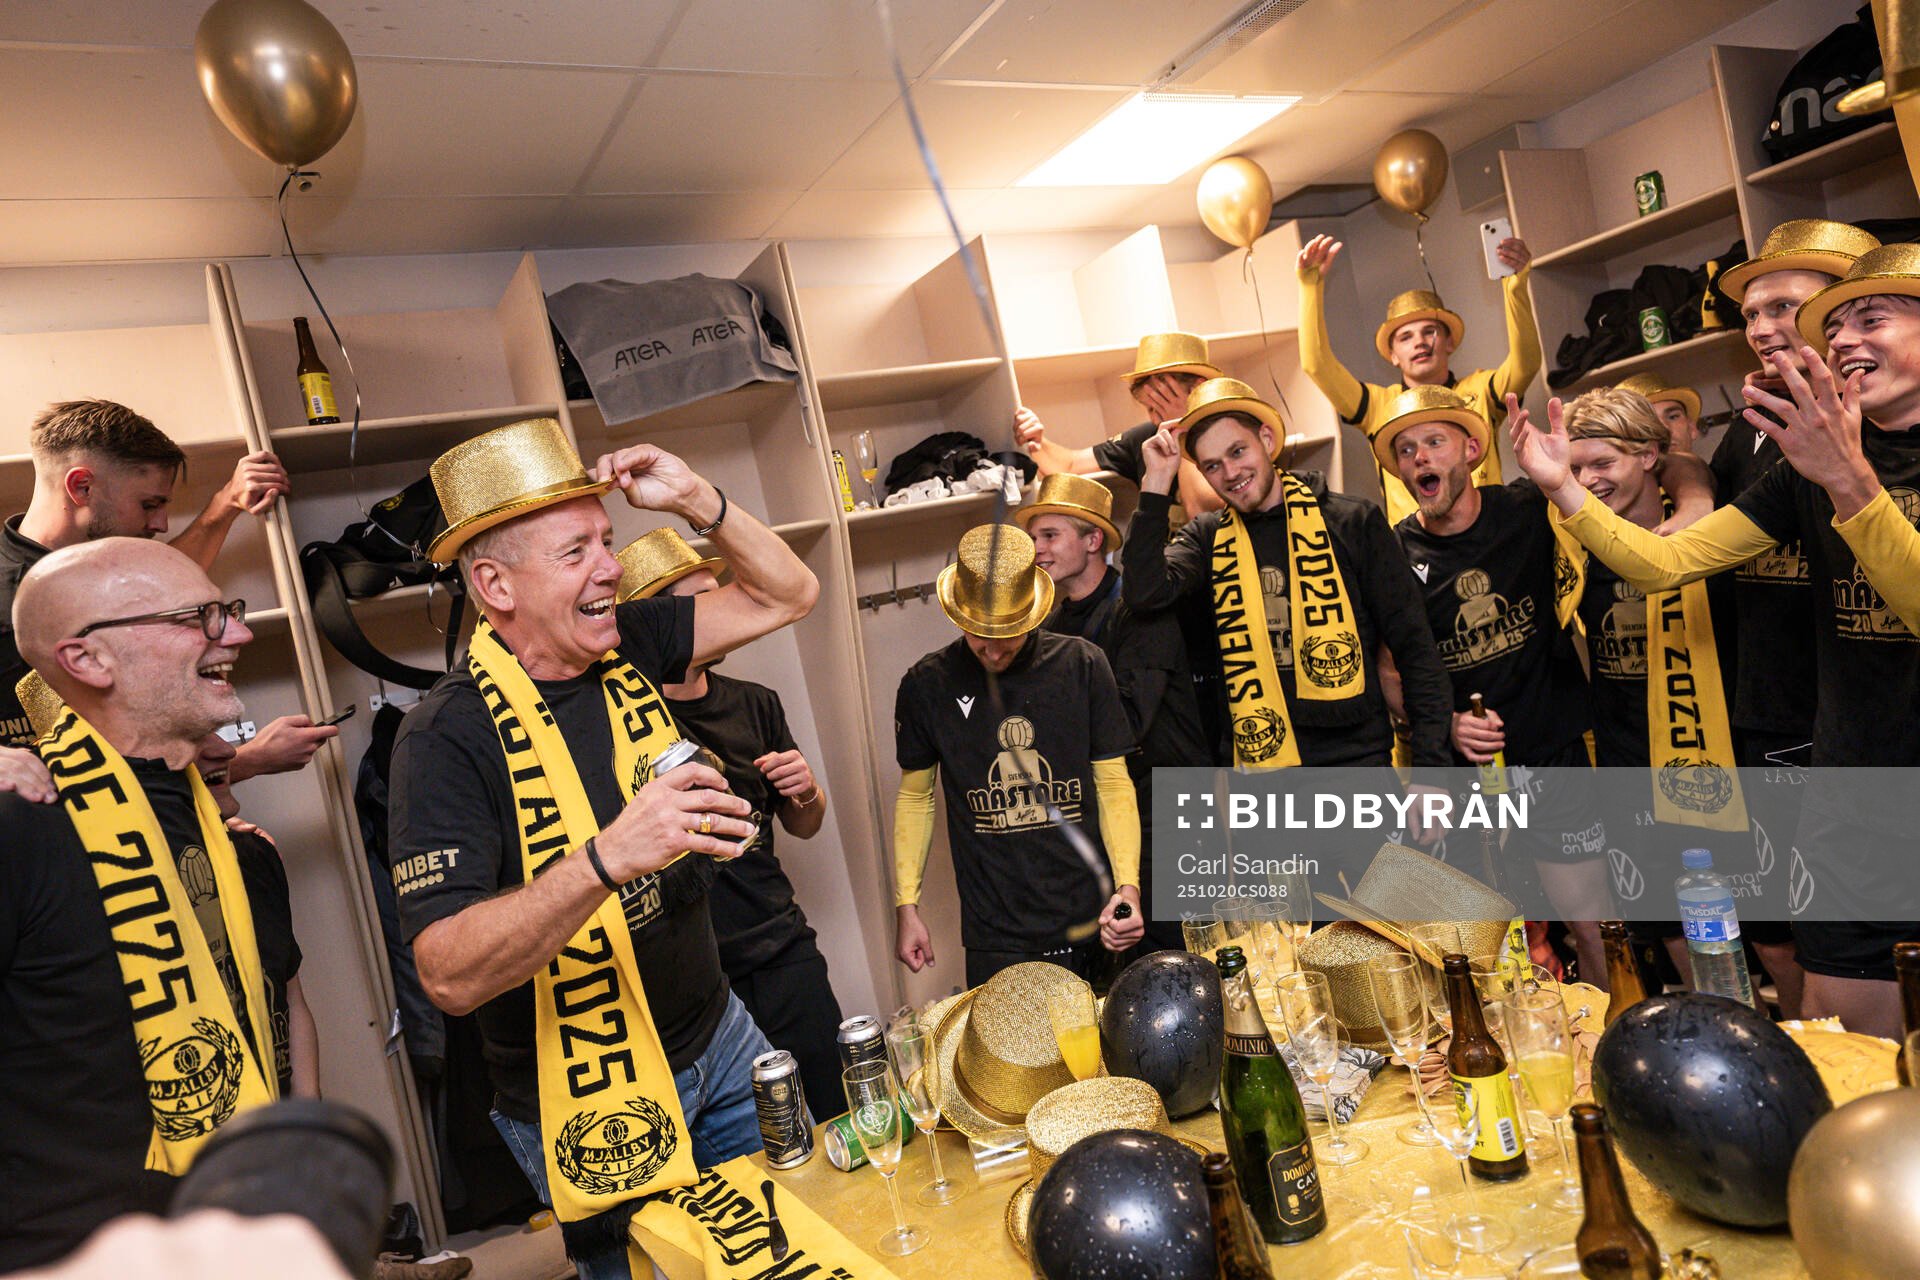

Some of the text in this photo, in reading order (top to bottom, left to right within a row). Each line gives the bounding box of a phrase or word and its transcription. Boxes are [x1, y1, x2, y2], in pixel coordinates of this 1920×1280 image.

[615, 320, 746, 370] ATEA ATEA
[1291, 530, 1345, 627] 2025
[1212, 536, 1264, 704] SVENSKA
[1852, 613, 1872, 633] 20
[967, 778, 1082, 813] MÄSTARE
[1563, 841, 1581, 855] on
[392, 848, 460, 888] UNIBET
[1726, 870, 1761, 885] mar
[640, 887, 662, 917] 20
[88, 830, 198, 1024] 2025
[548, 926, 638, 1099] 2025
[149, 1060, 219, 1099] MJÄLLBY
[175, 1088, 214, 1113] AIF
[580, 1136, 651, 1162] MJÄLLBY
[601, 1159, 635, 1173] AIF
[1296, 1169, 1317, 1191] CAV
